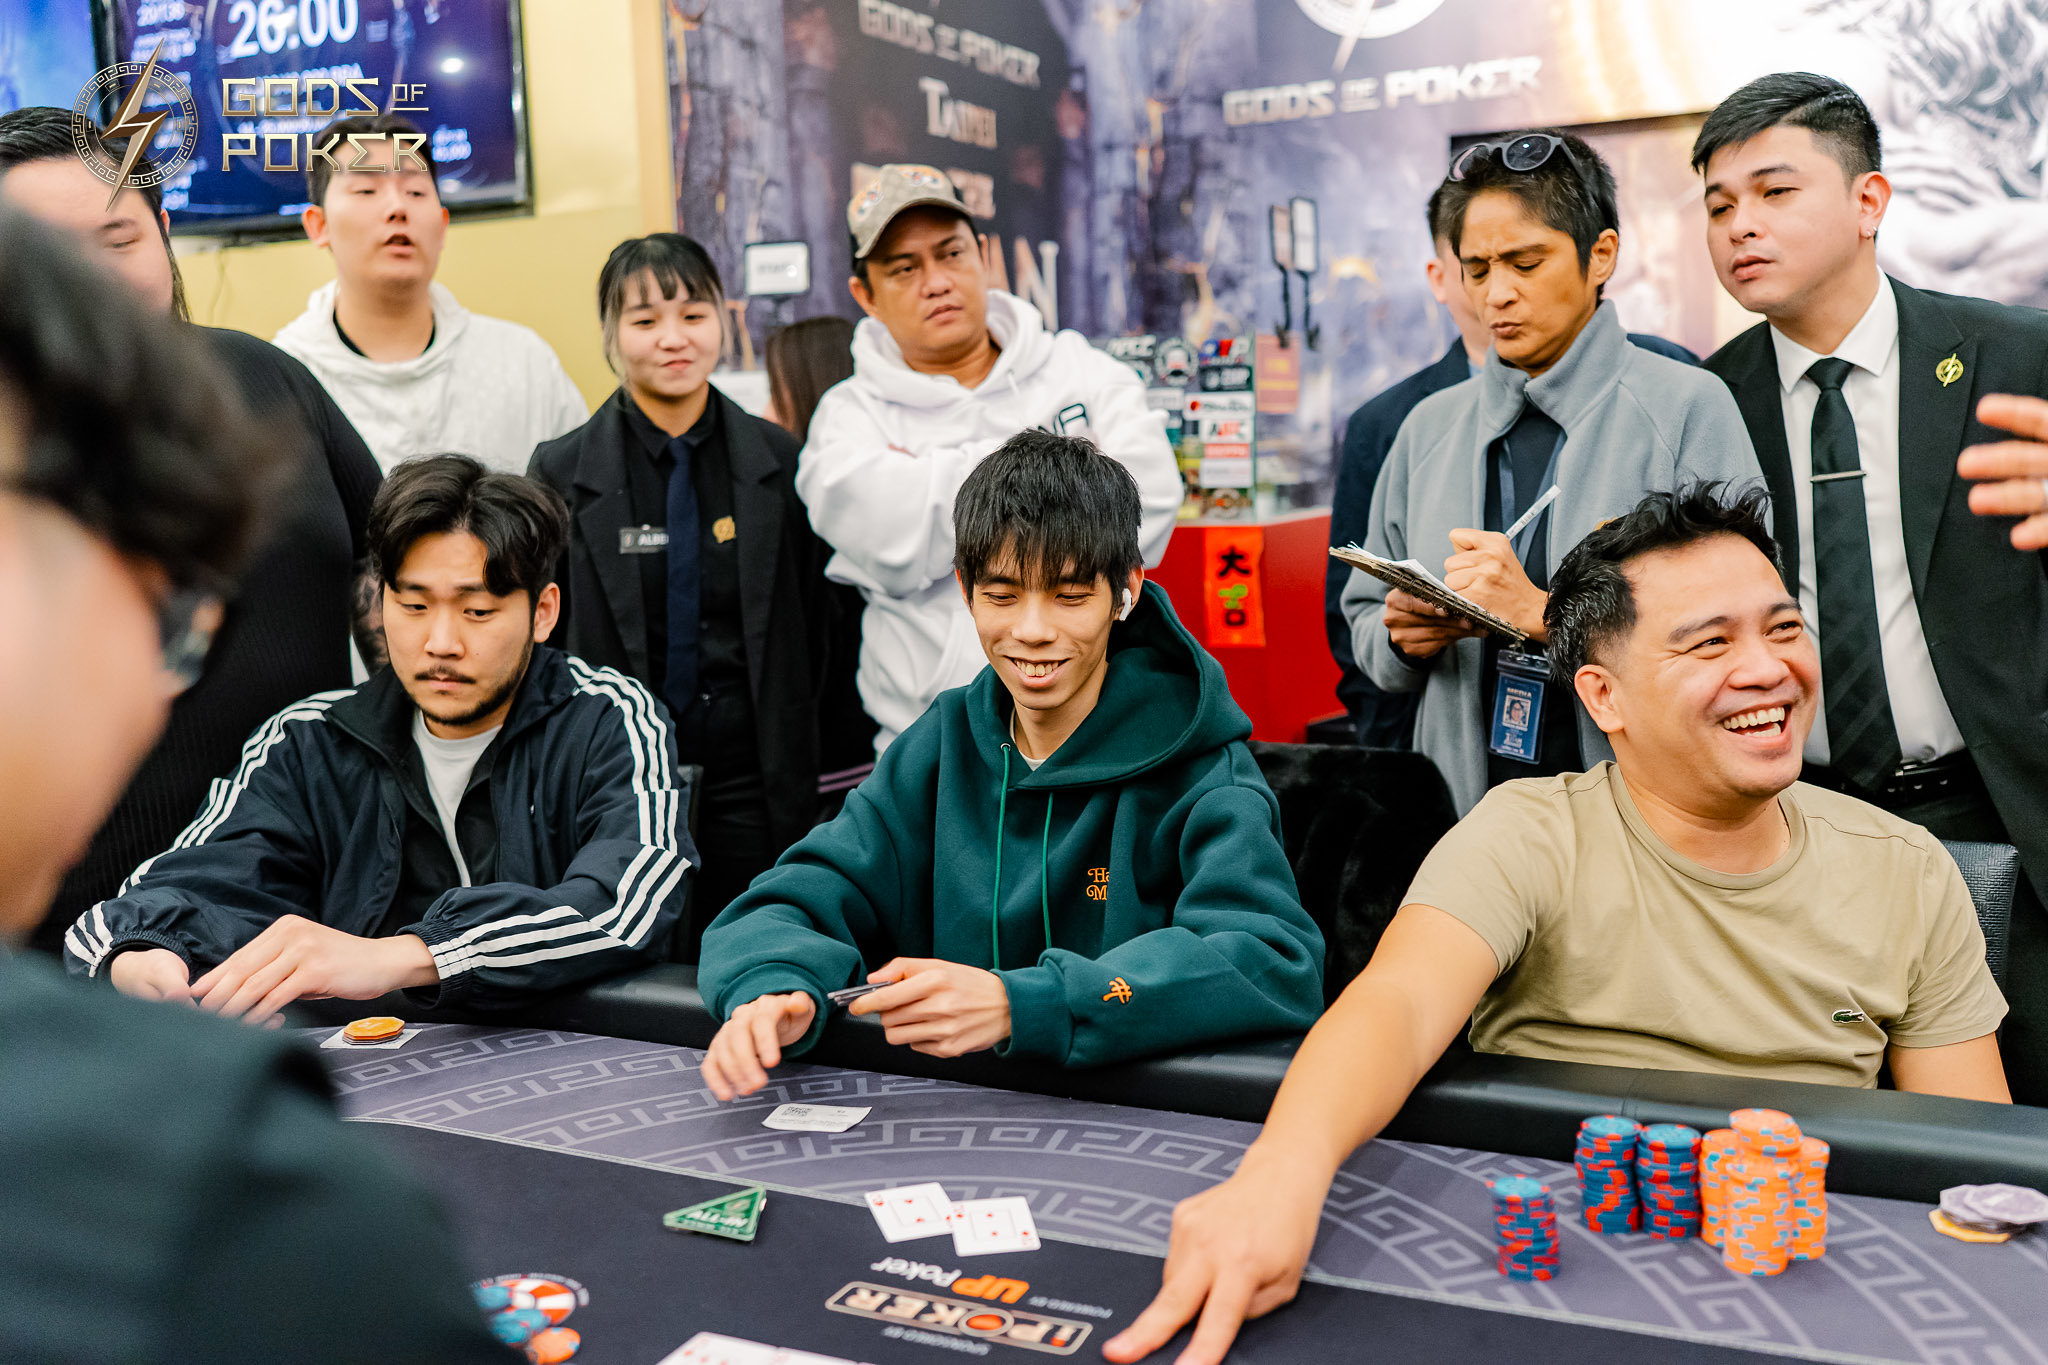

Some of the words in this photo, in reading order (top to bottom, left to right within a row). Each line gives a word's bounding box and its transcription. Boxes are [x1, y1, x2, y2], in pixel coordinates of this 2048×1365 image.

[858, 0, 934, 53] GODS
[959, 29, 1041, 89] POKER
[1223, 79, 1335, 125] GODS
[1384, 56, 1543, 108] POKER
[1086, 884, 1108, 901] M
[870, 1256, 962, 1287] Poker
[951, 1275, 1030, 1304] UP
